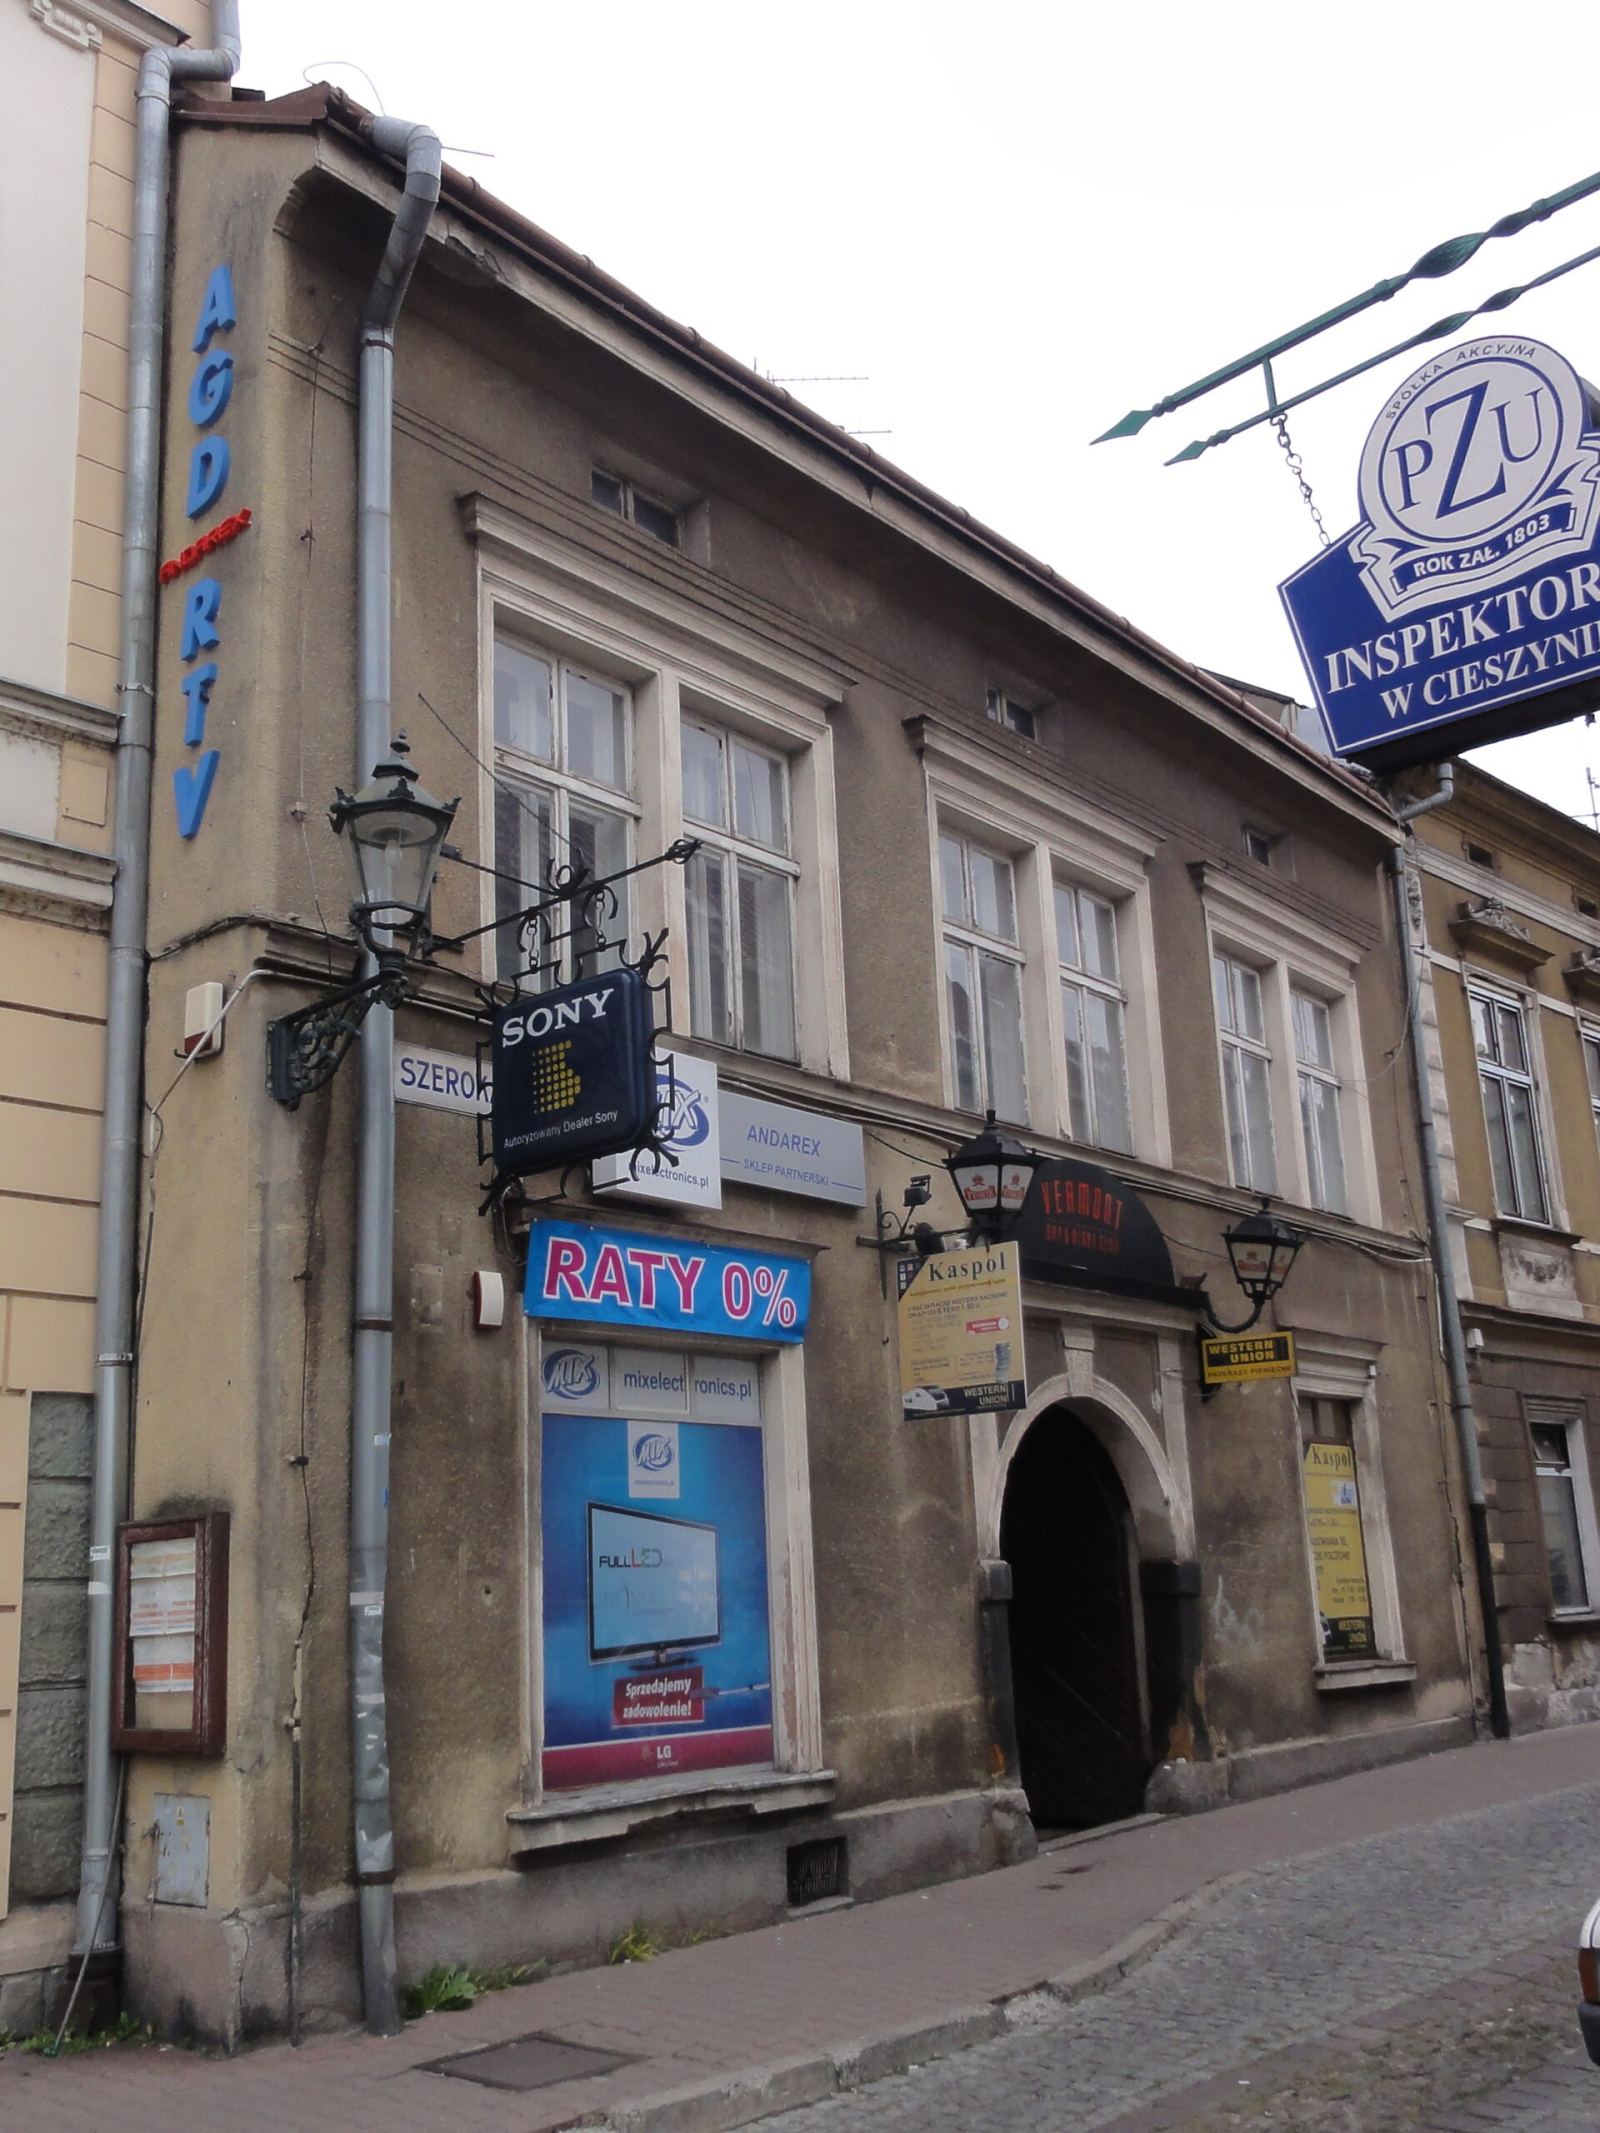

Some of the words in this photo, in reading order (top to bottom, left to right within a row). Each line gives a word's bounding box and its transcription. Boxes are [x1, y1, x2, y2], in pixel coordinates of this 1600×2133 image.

[1456, 343, 1537, 362] AKCYJNA
[185, 264, 237, 520] AGD
[1390, 379, 1544, 520] PZU
[1413, 555, 1455, 577] ROK
[1459, 544, 1500, 568] ZAŁ.
[1505, 514, 1550, 549] 1803
[1324, 562, 1600, 694] INSPEKTOR
[1380, 683, 1415, 719] W
[1423, 620, 1600, 706] CIESZYNI
[502, 988, 615, 1048] SONY
[504, 1125, 562, 1149] Autoryzowany
[563, 1114, 593, 1133] Dealer
[595, 1110, 619, 1125] Sony
[747, 1124, 821, 1157] ANDAREX
[635, 1163, 709, 1188] ixelectronics.pl
[743, 1159, 773, 1174] SKLEP
[775, 1165, 829, 1186] PARTNERSKI
[929, 1252, 1006, 1281] Kaspol
[543, 1236, 706, 1314] RATY
[722, 1262, 797, 1328] 0%
[1208, 1340, 1273, 1355] WESTERN
[1230, 1351, 1274, 1363] UNION
[547, 1353, 596, 1394] MIX
[963, 1384, 1006, 1397] WESTERN
[979, 1395, 1008, 1405] UNION
[1311, 1446, 1351, 1471] Kaspol
[625, 1677, 692, 1699] Sprzedajemy
[623, 1700, 691, 1719] zadowolenie!
[656, 1745, 671, 1760] LG
